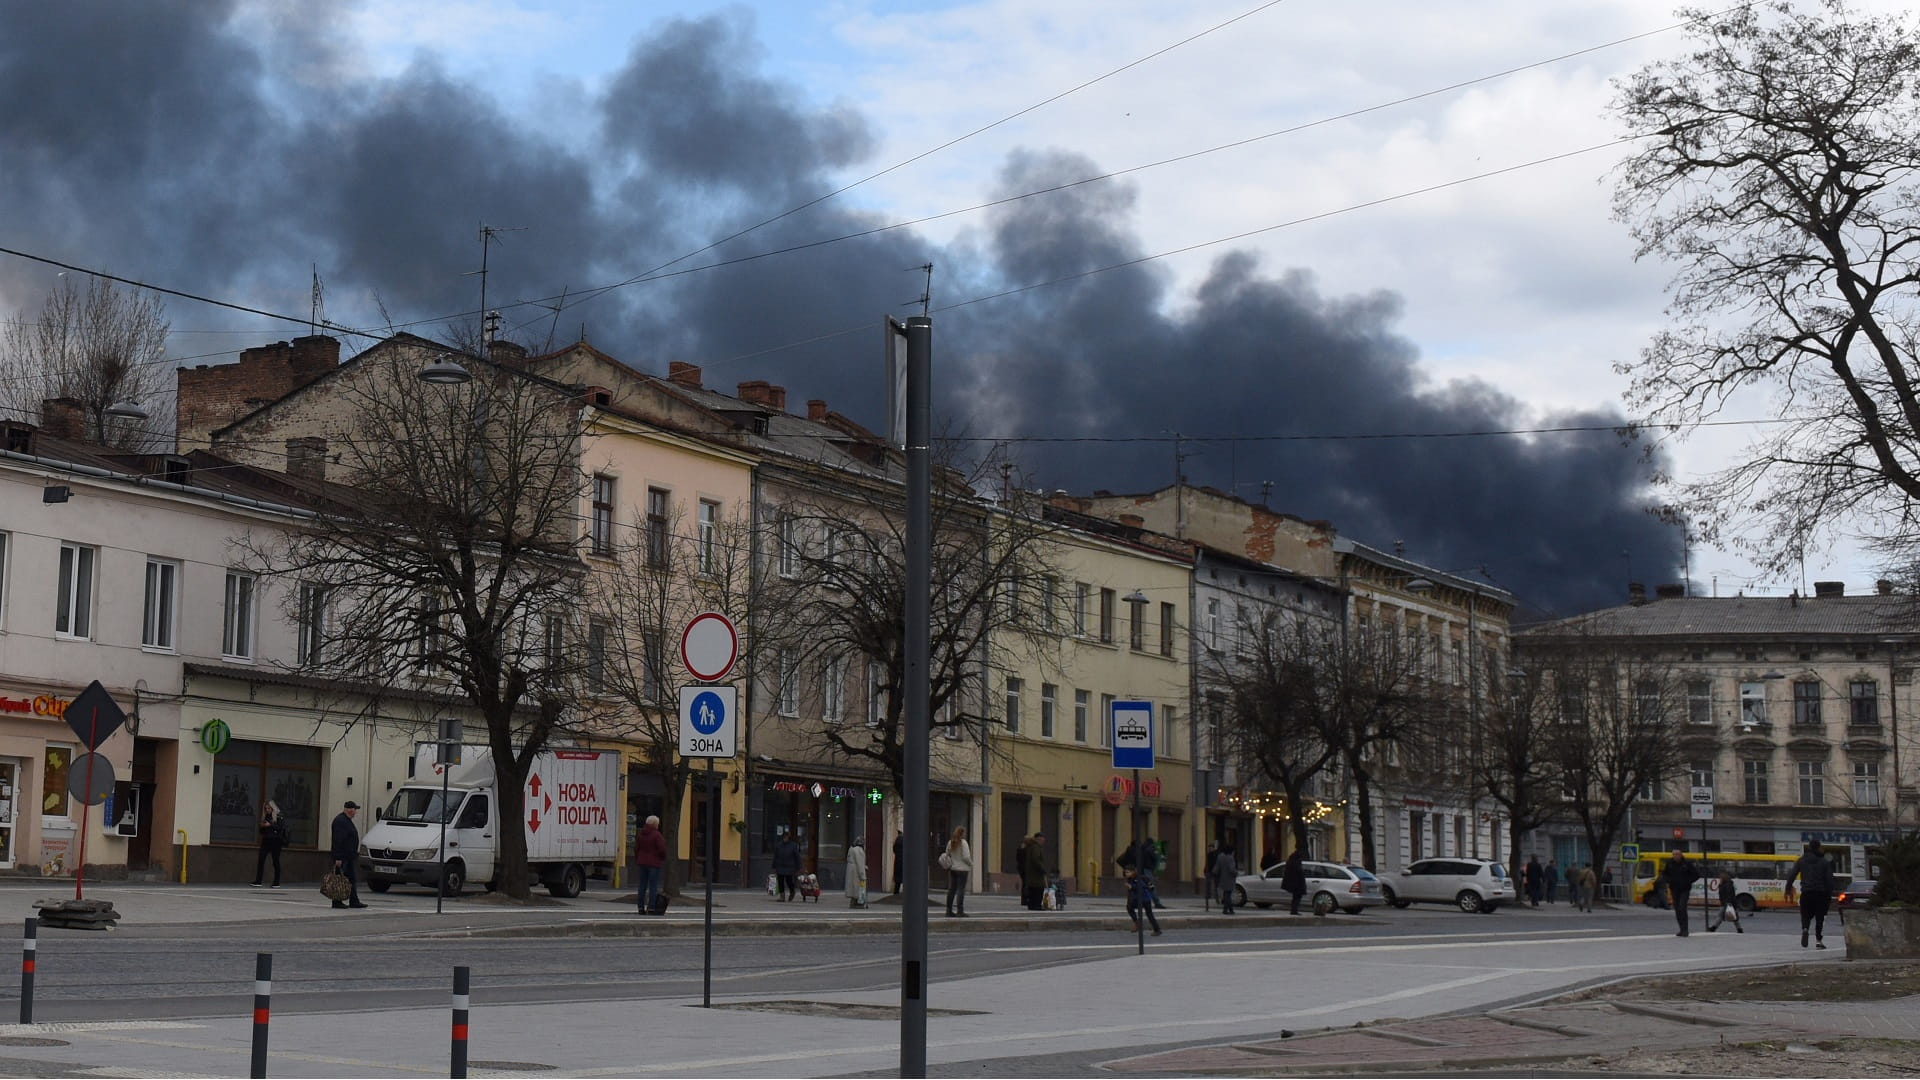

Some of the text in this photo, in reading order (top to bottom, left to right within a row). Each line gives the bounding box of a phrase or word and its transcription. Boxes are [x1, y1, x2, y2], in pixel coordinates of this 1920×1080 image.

[690, 739, 723, 752] ЗОНА
[558, 784, 596, 802] НОВА
[558, 806, 608, 825] ПОШТА
